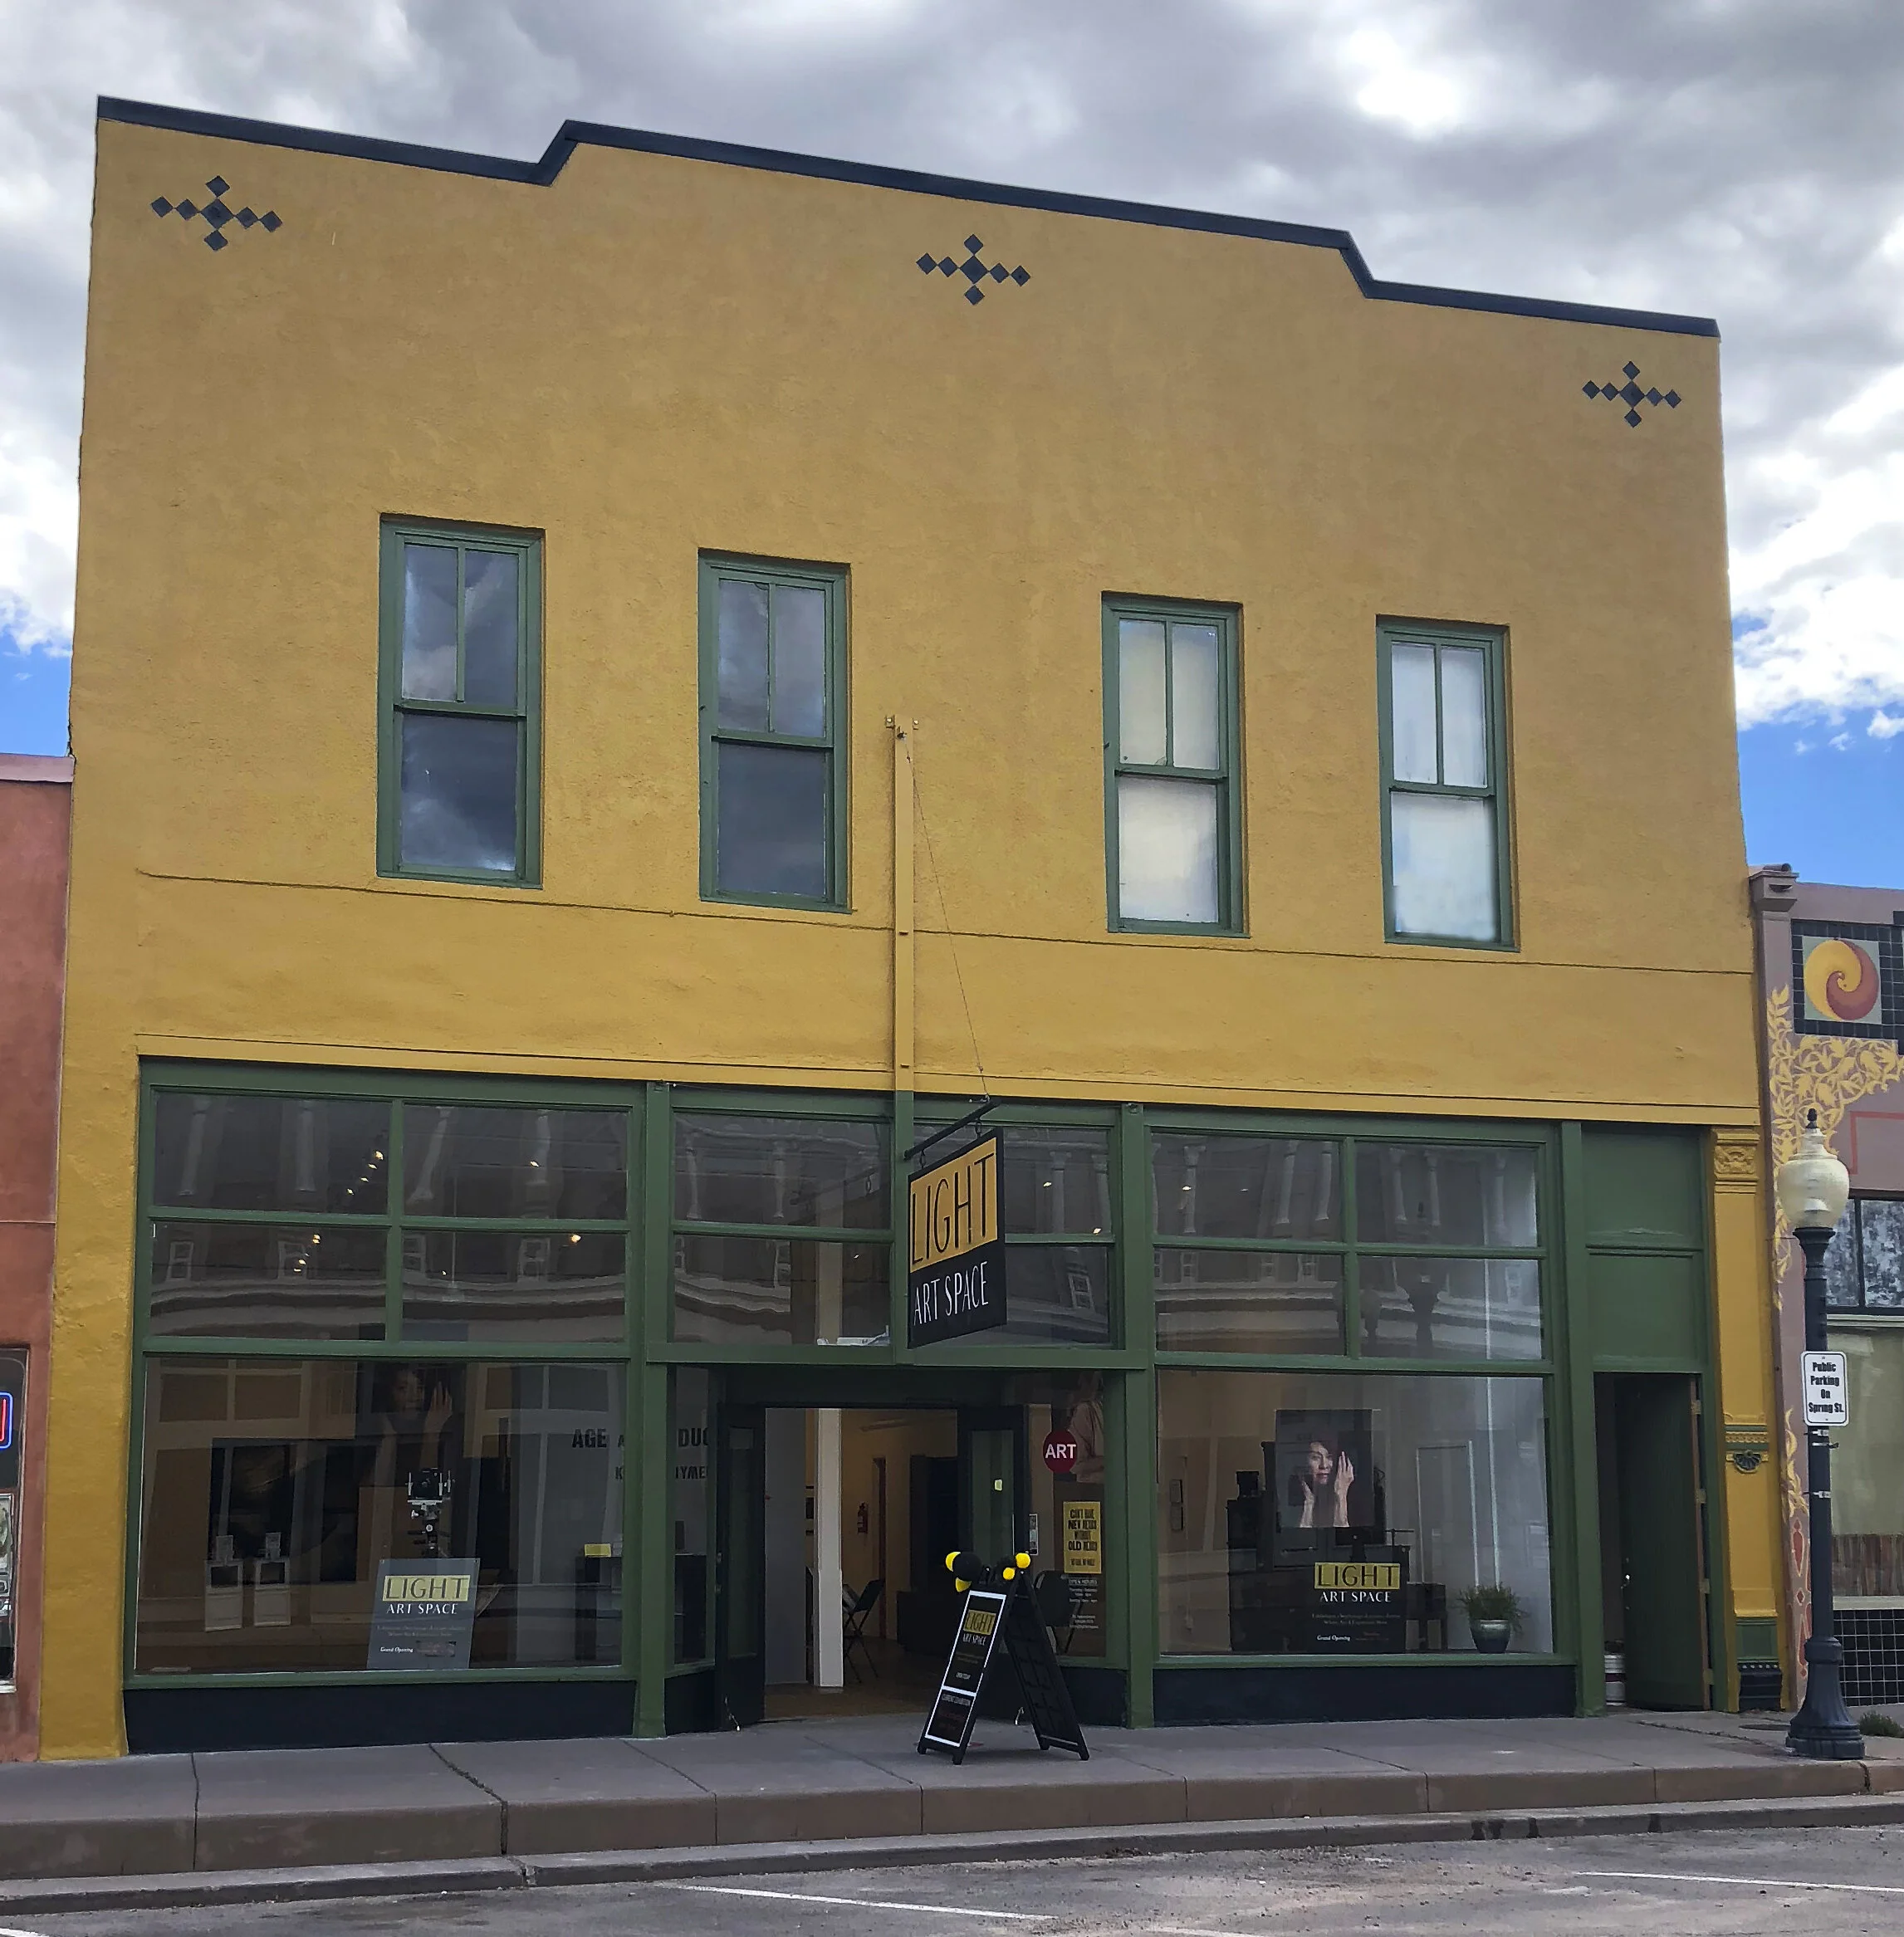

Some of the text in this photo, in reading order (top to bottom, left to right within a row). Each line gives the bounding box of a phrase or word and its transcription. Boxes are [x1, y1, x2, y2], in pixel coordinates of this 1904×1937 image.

[912, 1152, 995, 1266] LIGHT
[913, 1260, 990, 1327] ART SPACE
[1812, 1362, 1837, 1372] Public
[1810, 1375, 1840, 1387] Parking
[1820, 1389, 1831, 1399] On
[1809, 1401, 1833, 1413] Spring
[571, 1427, 608, 1449] AGE
[1045, 1443, 1077, 1459] ART
[1068, 1540, 1082, 1551] OLD
[1317, 1564, 1400, 1587] LIGHT
[385, 1577, 470, 1599] LIGHT
[1319, 1591, 1392, 1602] ART SPACE
[386, 1603, 458, 1615] ART SPACE
[964, 1611, 996, 1633] LIGHT
